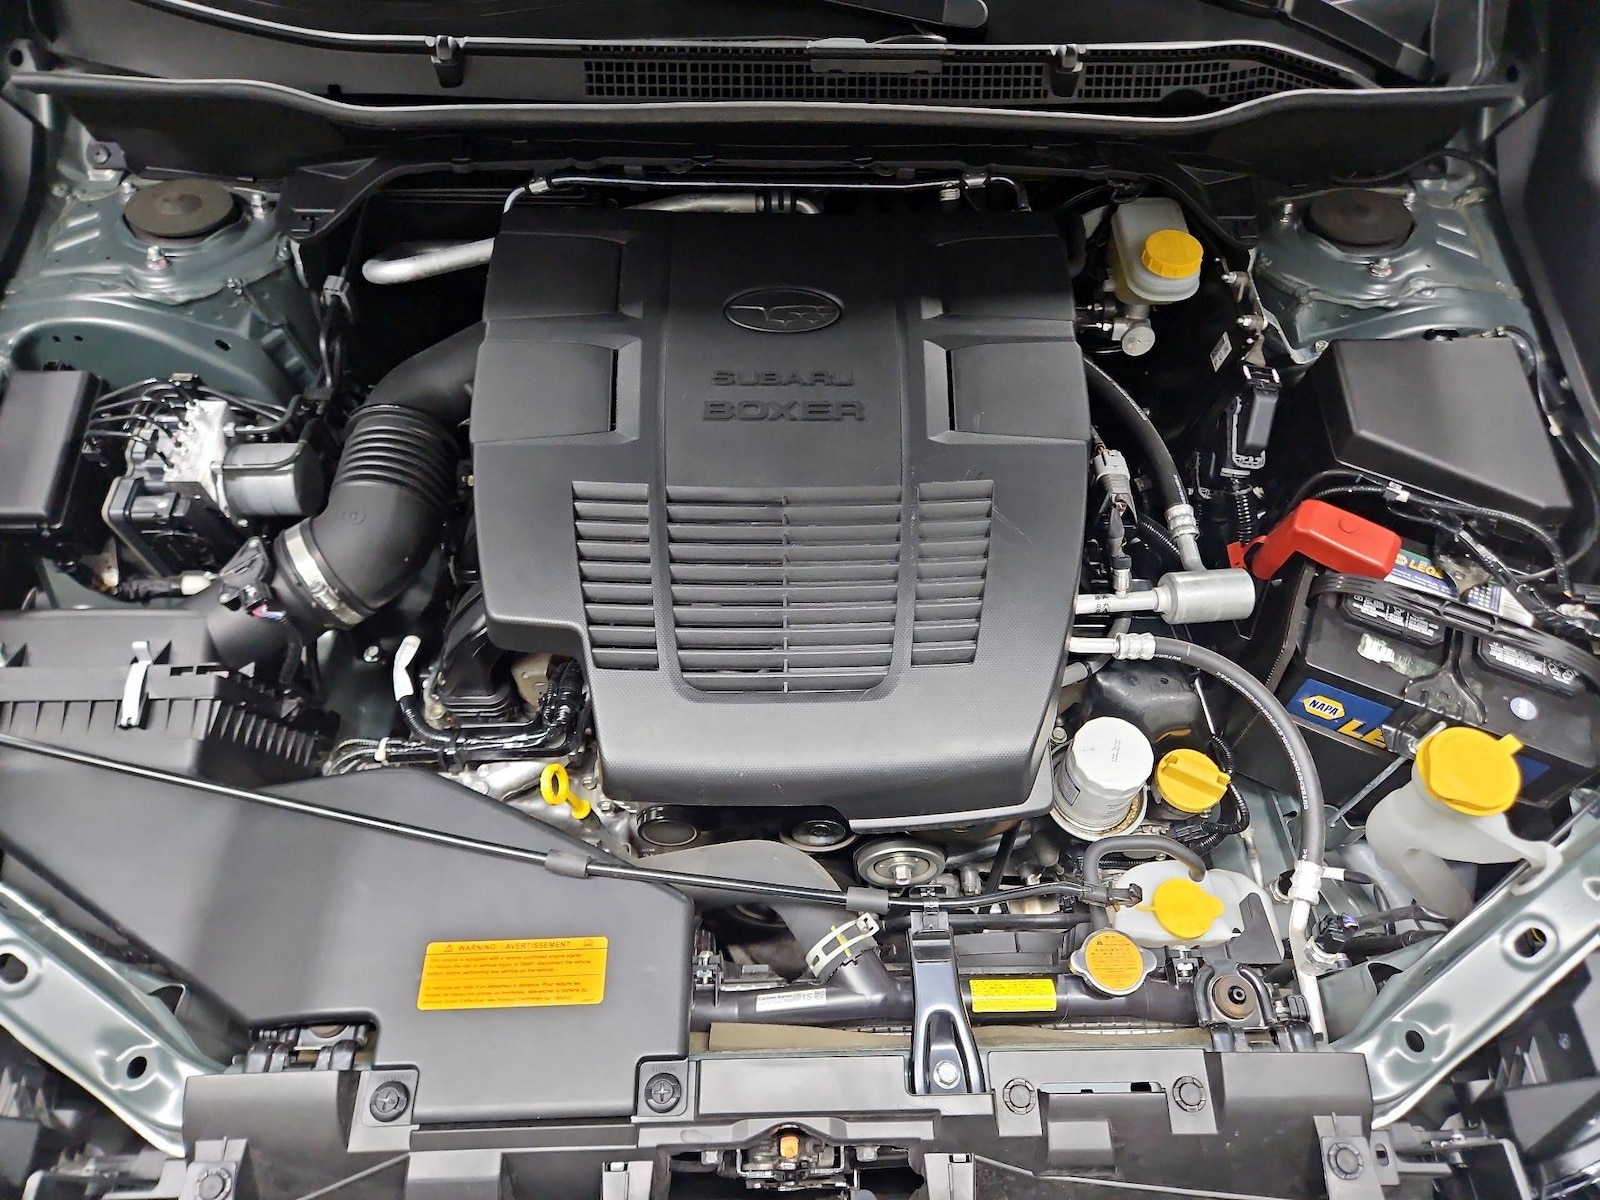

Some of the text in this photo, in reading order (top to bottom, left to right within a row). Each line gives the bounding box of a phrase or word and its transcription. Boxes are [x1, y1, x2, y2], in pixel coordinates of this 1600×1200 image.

[712, 370, 855, 386] SUBARU
[703, 400, 866, 421] BOXER
[1309, 699, 1339, 716] NAPA
[458, 940, 570, 951] WARNING AVERTISSEMENT
